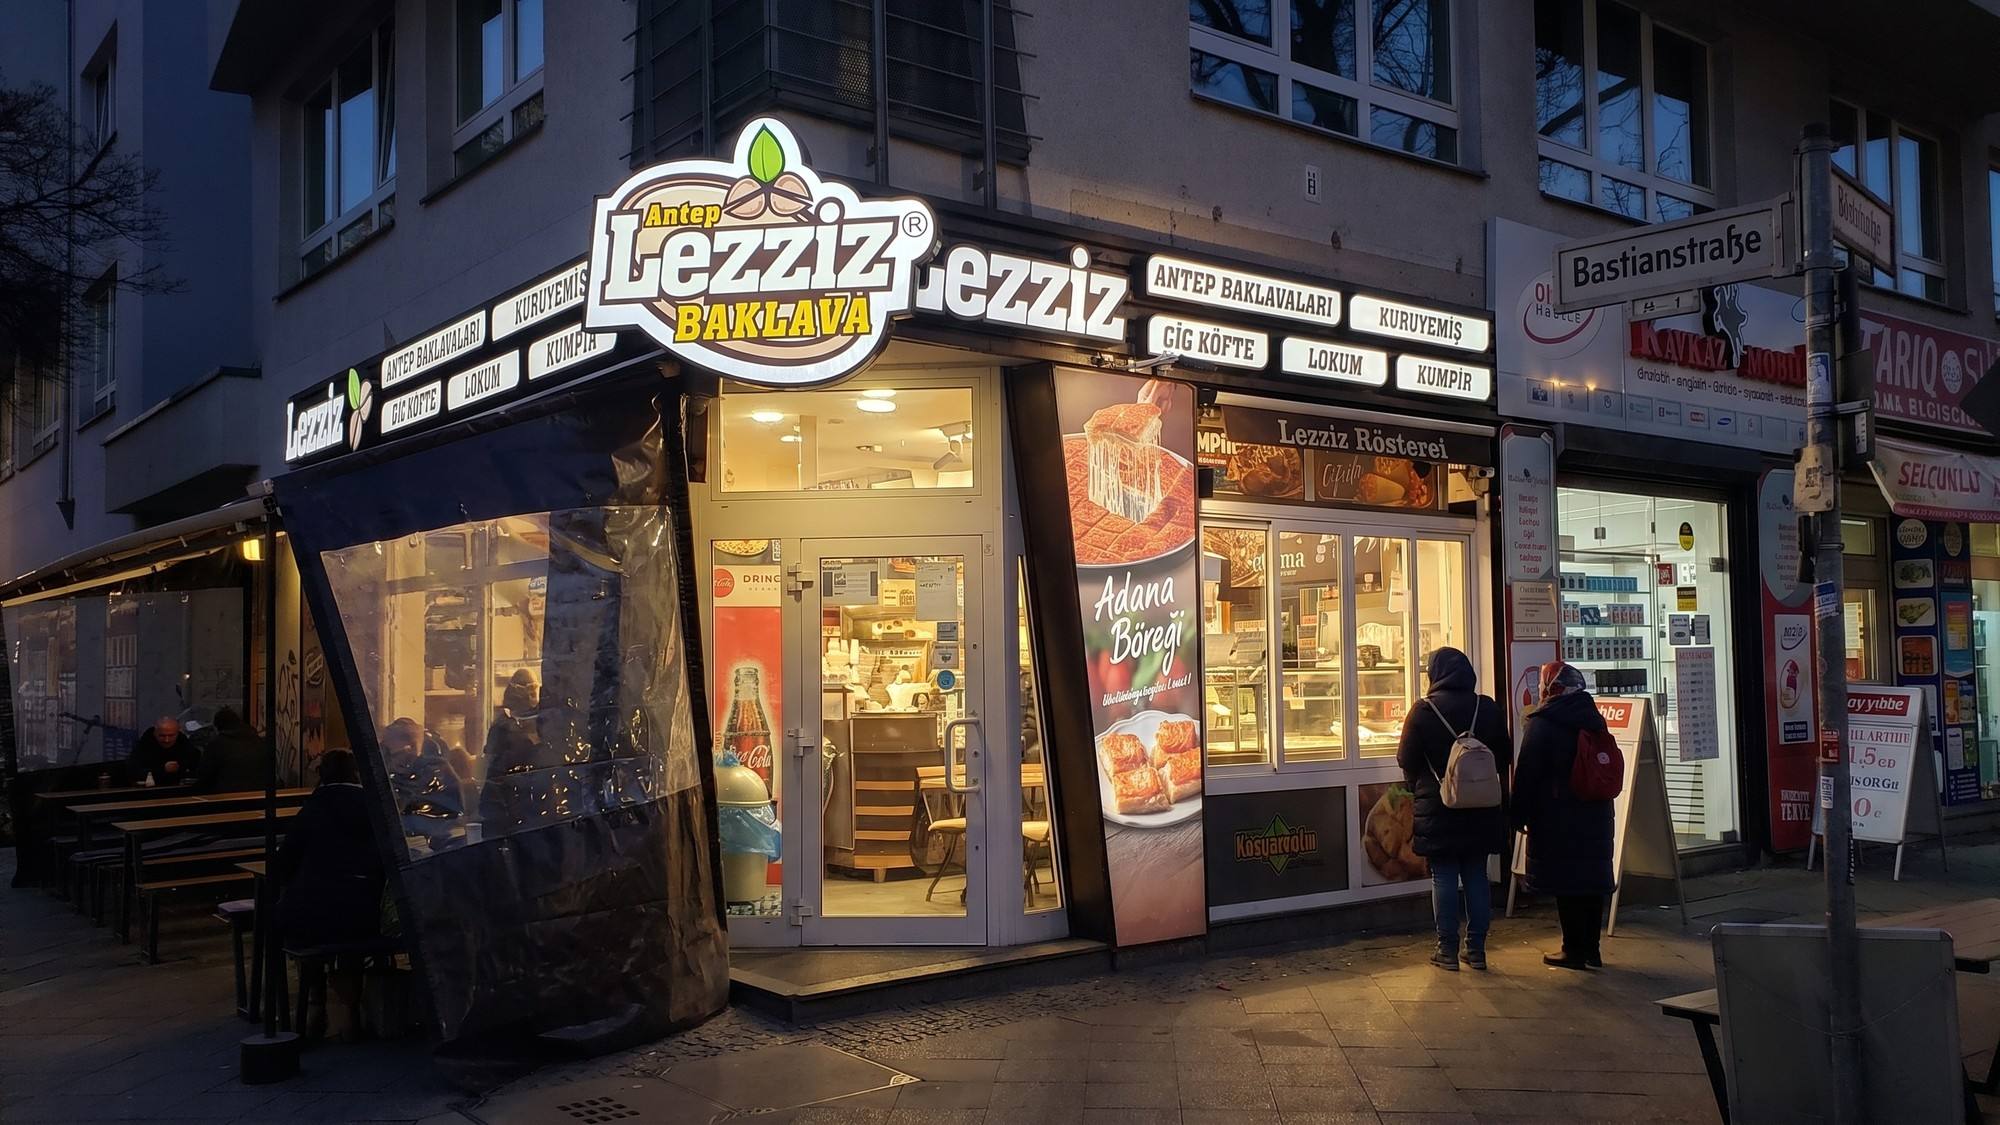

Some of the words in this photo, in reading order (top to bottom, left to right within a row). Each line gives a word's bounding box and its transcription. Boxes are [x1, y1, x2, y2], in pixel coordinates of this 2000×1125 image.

[644, 202, 722, 229] Antep
[603, 201, 899, 299] Lezziz
[1573, 224, 1762, 288] Bastianstraße
[1154, 264, 1216, 296] ANTEP
[1220, 276, 1333, 318] BAKLAVALARI
[673, 295, 872, 342] BAKLAVA
[1379, 306, 1463, 346] KURUYEMİŞ
[386, 353, 415, 382] ANTEP
[416, 317, 481, 369] BAKLAVALARI
[1197, 327, 1255, 361] KÖFTE
[1307, 347, 1363, 377] LOKUM
[464, 363, 501, 399] LOKUM
[1416, 364, 1473, 393] KUMPİR
[285, 382, 345, 461] Lezziz
[1277, 419, 1349, 449] Lezziz
[1354, 428, 1448, 459] Rösterei
[1094, 571, 1175, 621] Adana
[1109, 610, 1185, 676] Böreği
